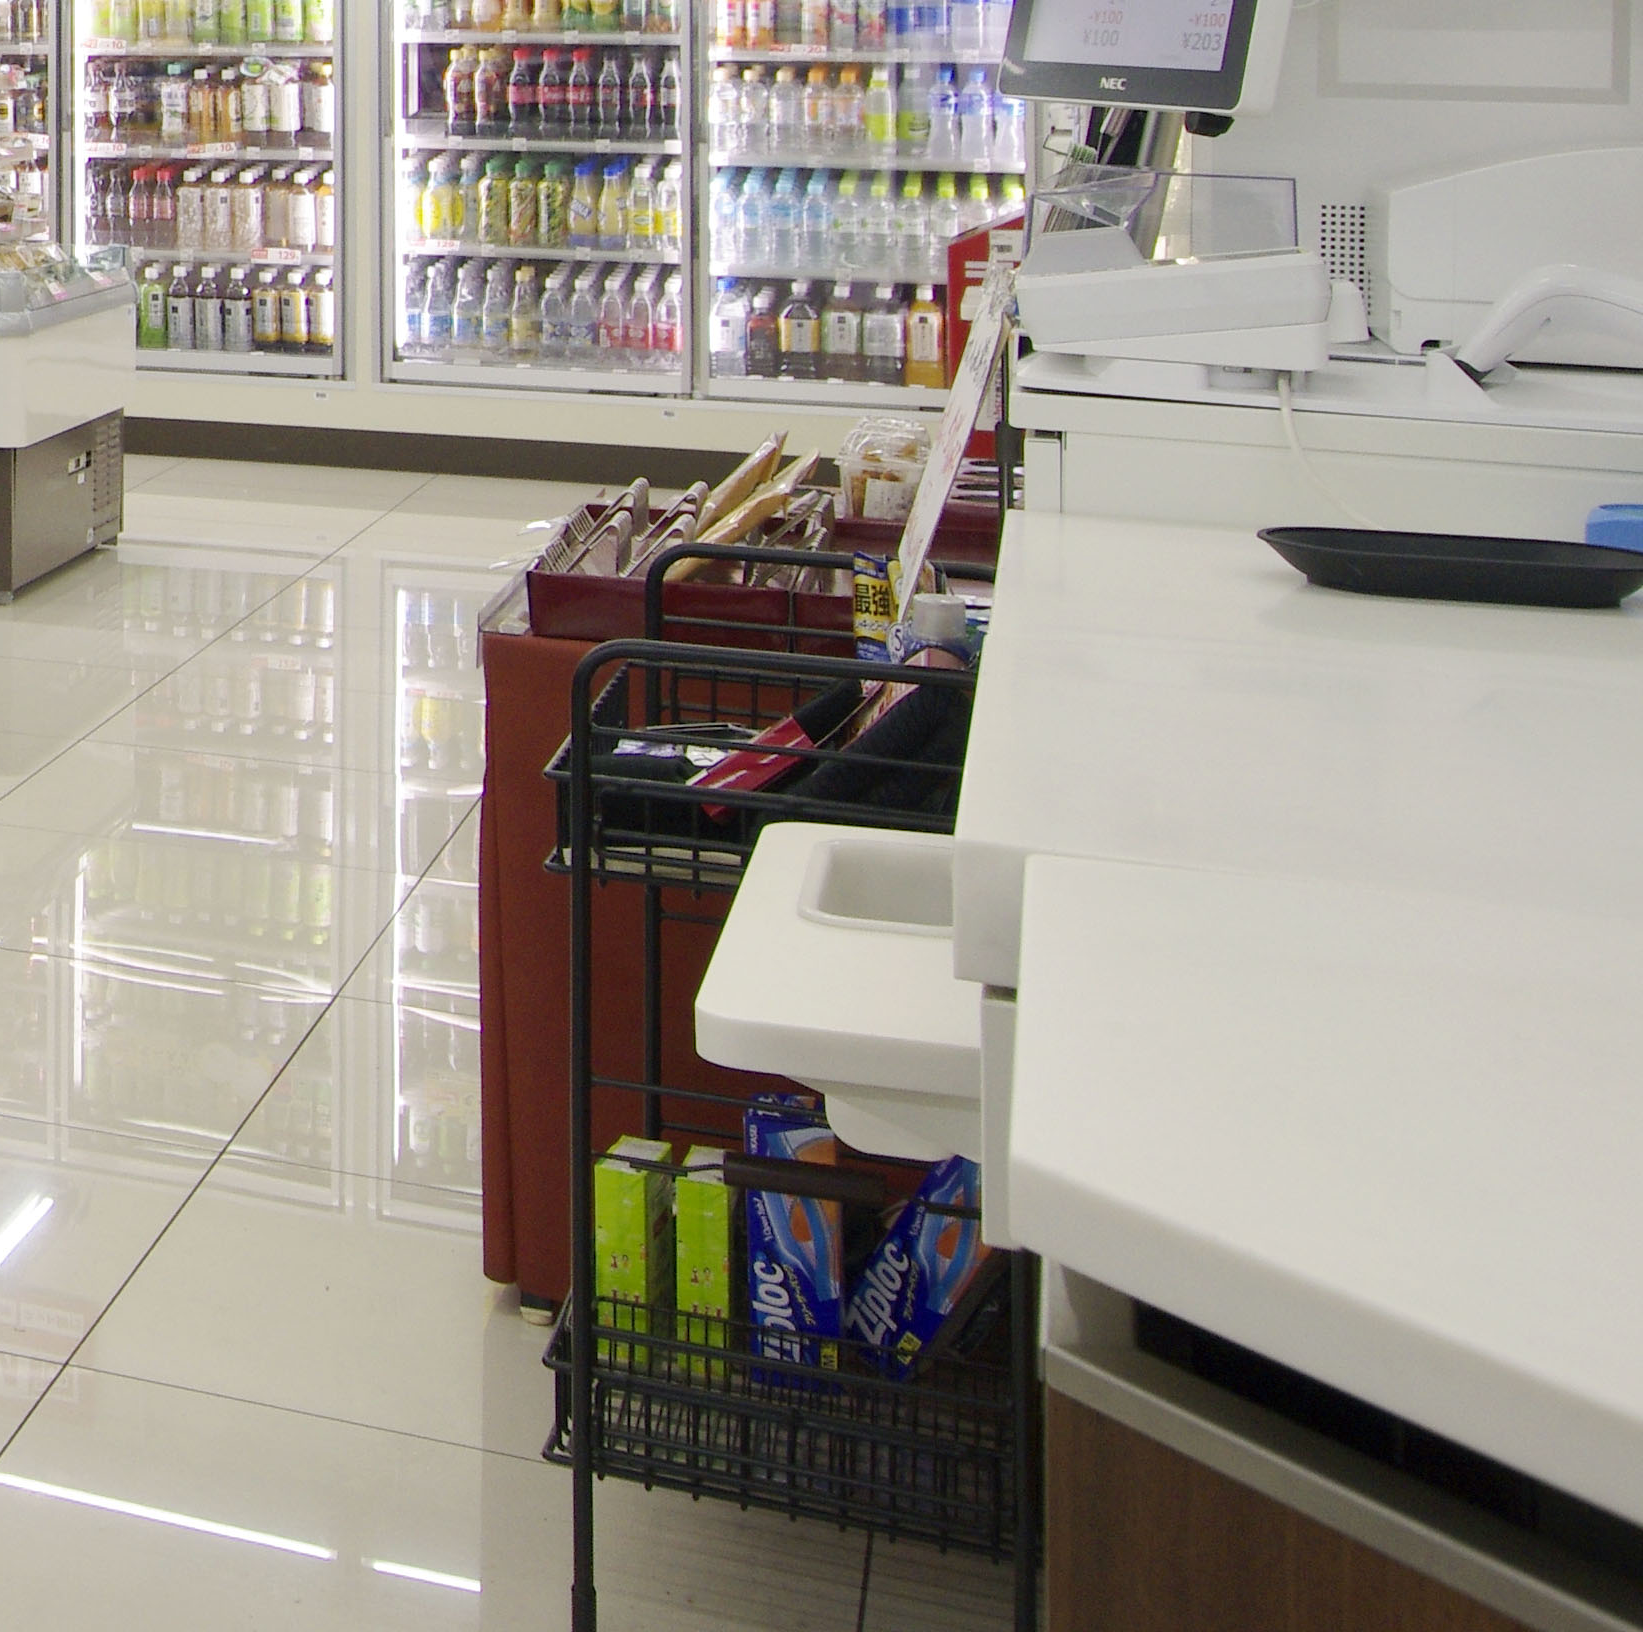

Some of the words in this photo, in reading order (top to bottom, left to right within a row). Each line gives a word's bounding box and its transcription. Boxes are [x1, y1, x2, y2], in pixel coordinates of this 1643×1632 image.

[1082, 29, 1120, 47] ¥100
[1182, 31, 1224, 52] ¥203
[1099, 76, 1128, 91] NEC
[855, 583, 891, 617] 最強
[846, 1242, 911, 1346] Ziploc
[750, 1258, 809, 1364] Ziploc
